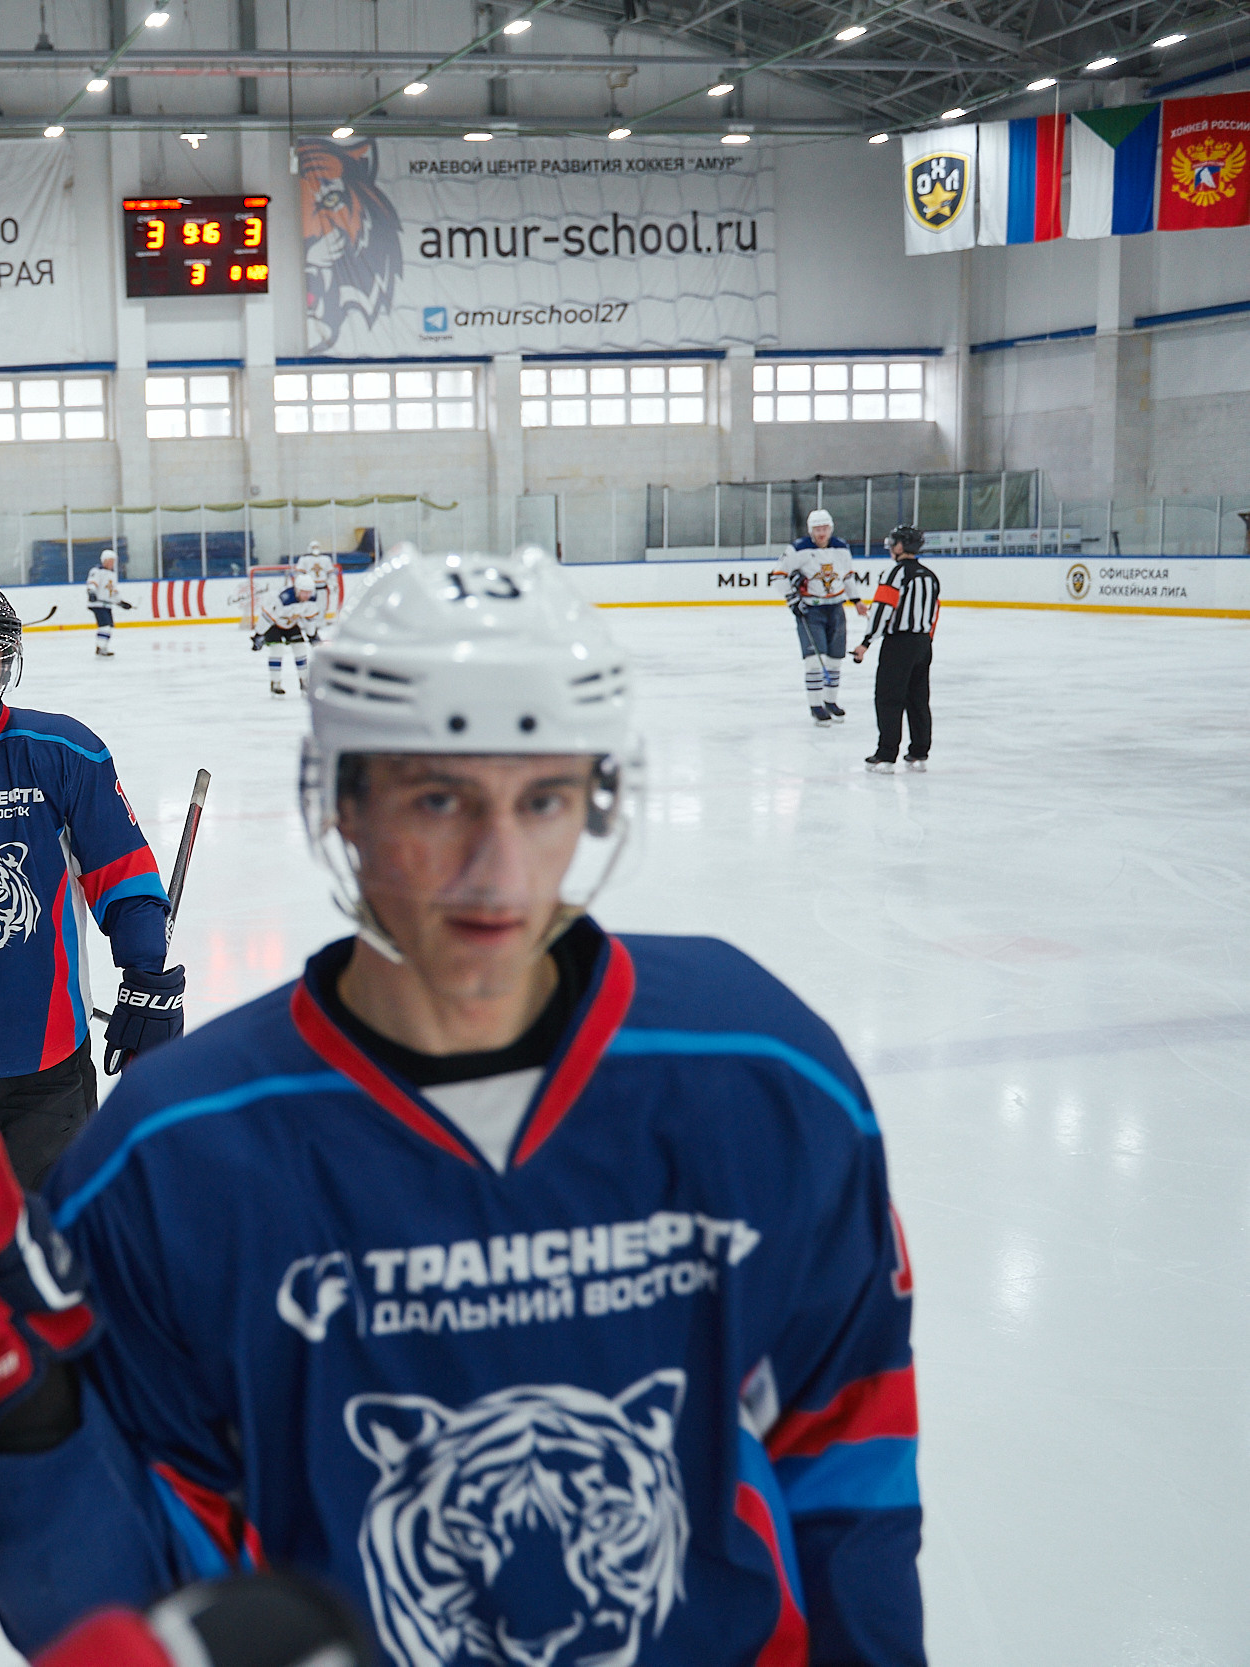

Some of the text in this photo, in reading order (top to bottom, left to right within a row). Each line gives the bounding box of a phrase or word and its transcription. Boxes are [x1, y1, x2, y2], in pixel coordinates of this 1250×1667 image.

[1170, 120, 1250, 139] ХОККЕЙ РОССИИ
[409, 156, 483, 175] КРАЕВОЙ
[486, 158, 537, 176] ЦЕНТР
[540, 158, 622, 174] РАЗВИТИЯ
[625, 156, 684, 173] ХОККЕЯ
[146, 219, 166, 249] 3
[244, 217, 263, 248] 3
[419, 210, 758, 259] amur-school.ru
[190, 263, 206, 286] 3
[454, 302, 630, 327] amurschool27
[718, 573, 758, 588] МЫ
[1099, 567, 1169, 580] ОФИЦЕРСКАЯ
[1098, 584, 1188, 598] ХОККЕЙНАЯ ЛИГА
[118, 987, 184, 1011] BAUE
[363, 1211, 761, 1295] ТРАНСНЕФТЬ
[371, 1277, 575, 1337] ДАЛЬНИЙ
